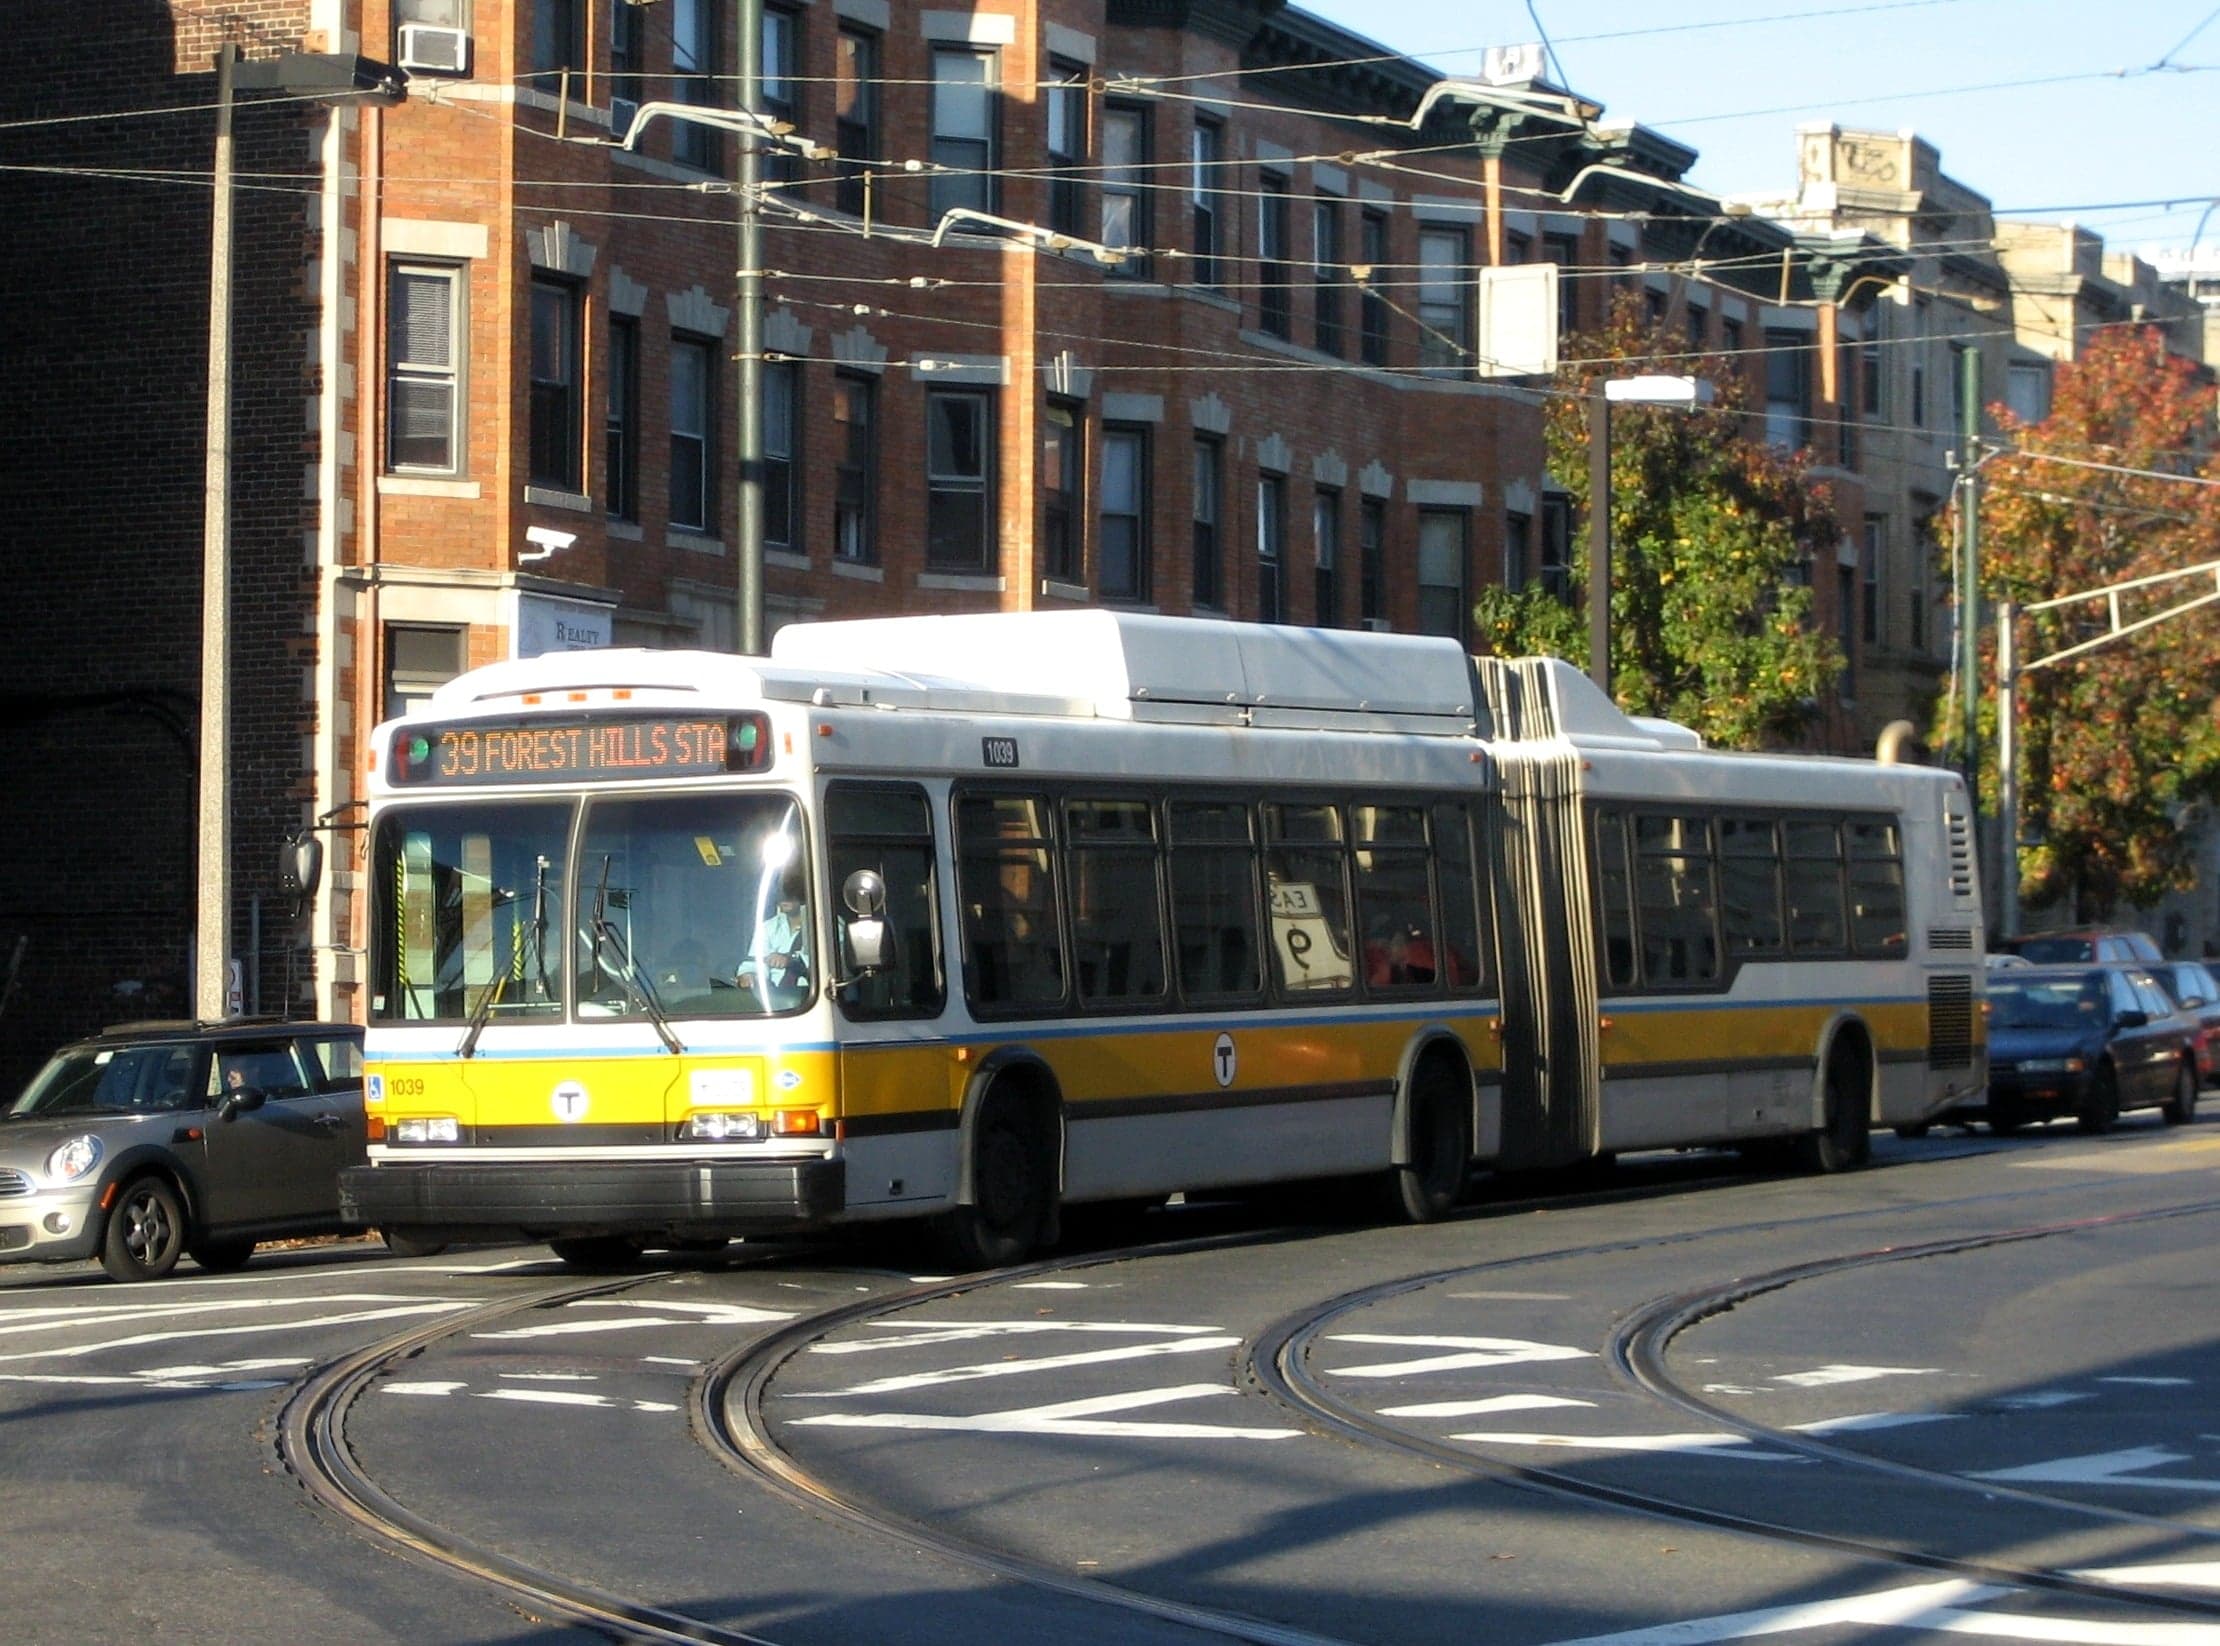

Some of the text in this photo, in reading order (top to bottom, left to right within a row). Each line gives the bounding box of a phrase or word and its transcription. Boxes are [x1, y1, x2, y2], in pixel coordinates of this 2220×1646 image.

[441, 722, 726, 776] 39 FOREST HILLS STA
[988, 741, 1014, 764] 1039
[1217, 1046, 1232, 1078] T
[390, 1078, 425, 1096] 1039
[558, 1092, 580, 1114] T
